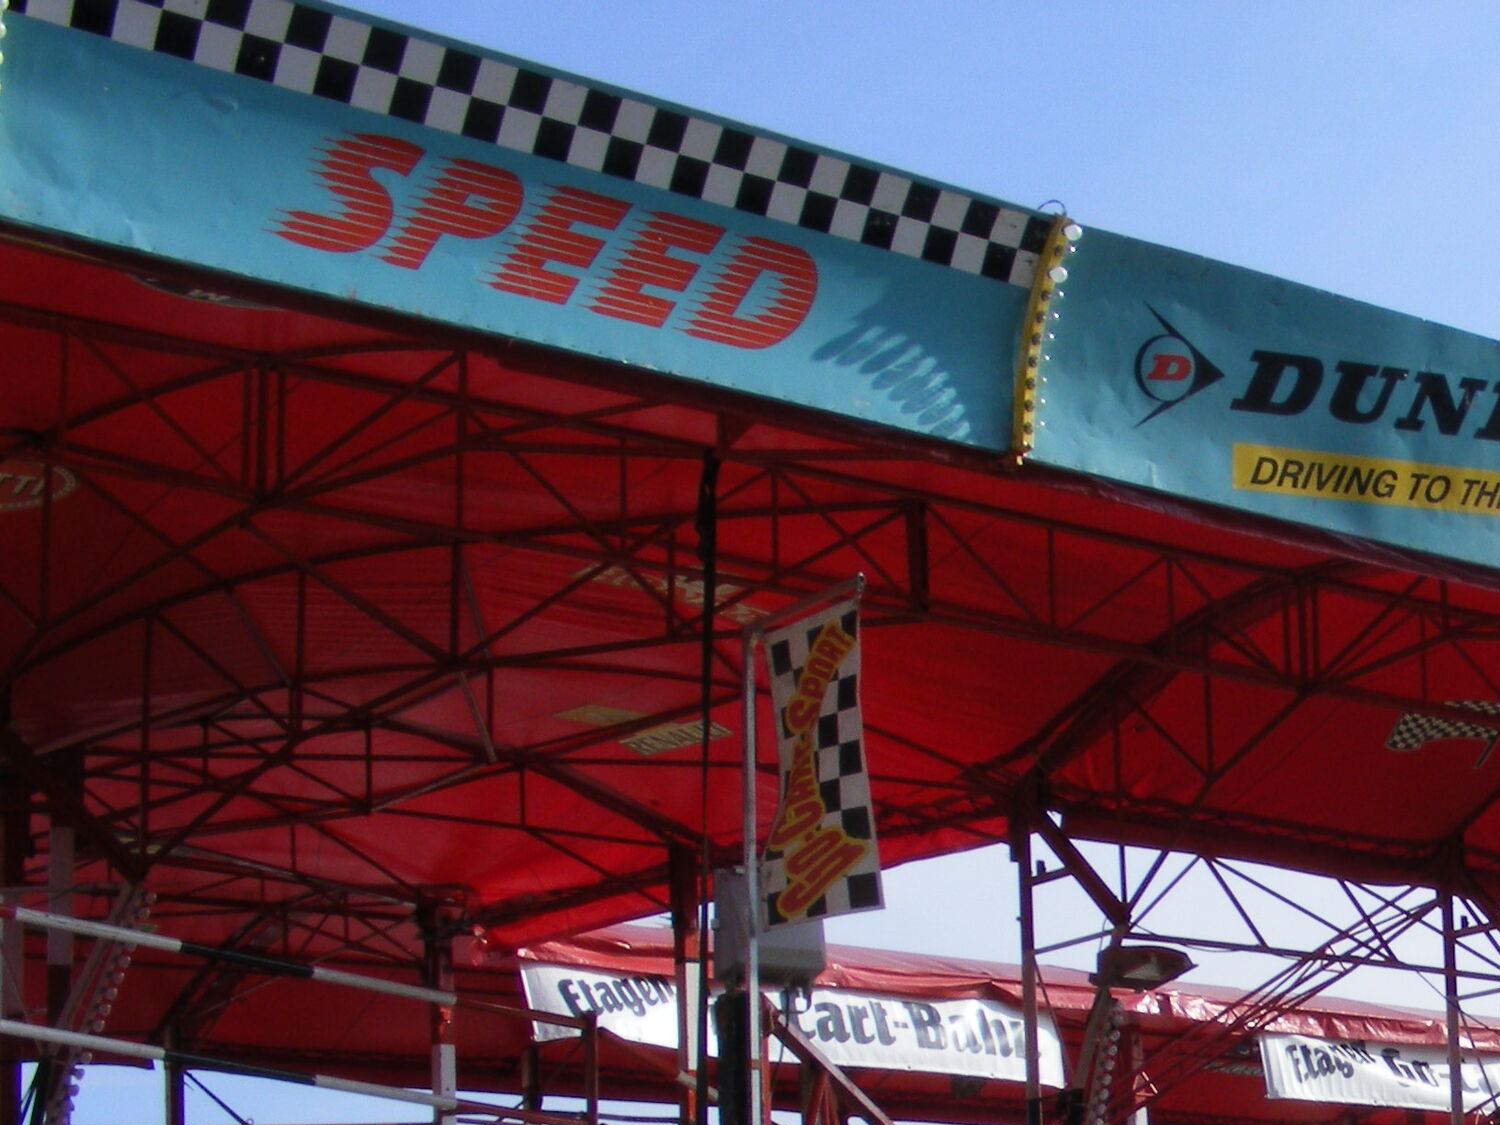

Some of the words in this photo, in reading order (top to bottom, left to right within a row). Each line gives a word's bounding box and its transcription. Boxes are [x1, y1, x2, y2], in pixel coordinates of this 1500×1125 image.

[264, 131, 818, 350] SPEED
[1250, 457, 1398, 498] DRIVING
[1408, 472, 1451, 504] TO
